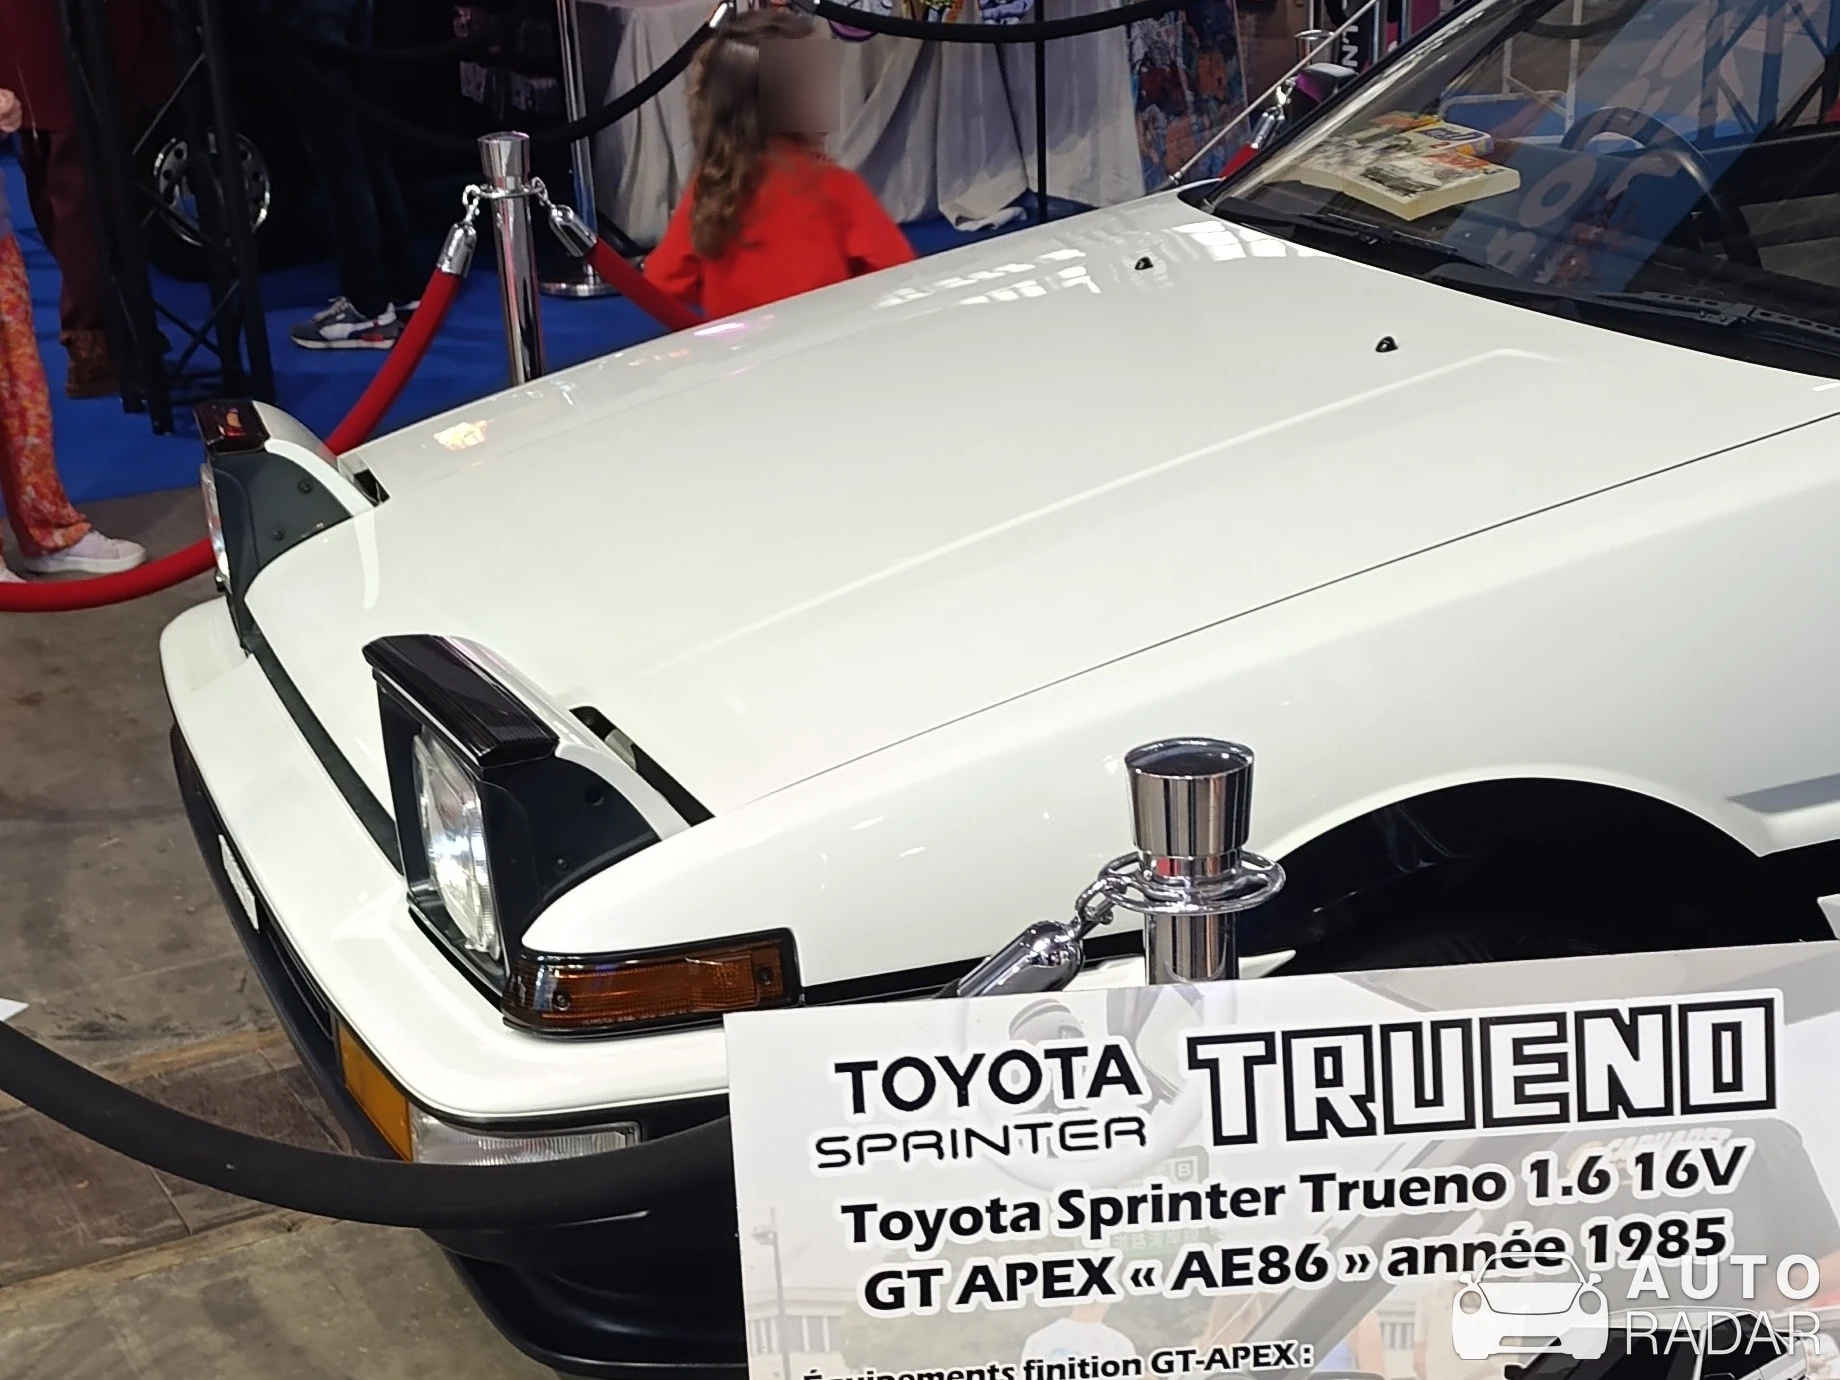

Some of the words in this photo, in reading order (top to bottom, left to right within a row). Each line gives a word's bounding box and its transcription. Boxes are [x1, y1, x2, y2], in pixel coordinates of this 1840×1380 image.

[834, 1044, 1143, 1114] TOYOTA
[1186, 997, 1777, 1147] TRUENO
[815, 1116, 1146, 1169] SPRINTER
[840, 1197, 1041, 1252] Toyota
[1057, 1183, 1286, 1241] Sprinter
[1299, 1171, 1507, 1213] Trueno
[1530, 1155, 1611, 1198] 1.6
[1635, 1145, 1748, 1192] 16V
[864, 1267, 944, 1311] GT
[955, 1256, 1116, 1305] APEX
[1170, 1243, 1328, 1291] AE86
[1387, 1229, 1566, 1277] année
[1588, 1216, 1727, 1264] 1985
[1023, 1356, 1142, 1380] finition
[1151, 1343, 1295, 1374] GT-APEX
